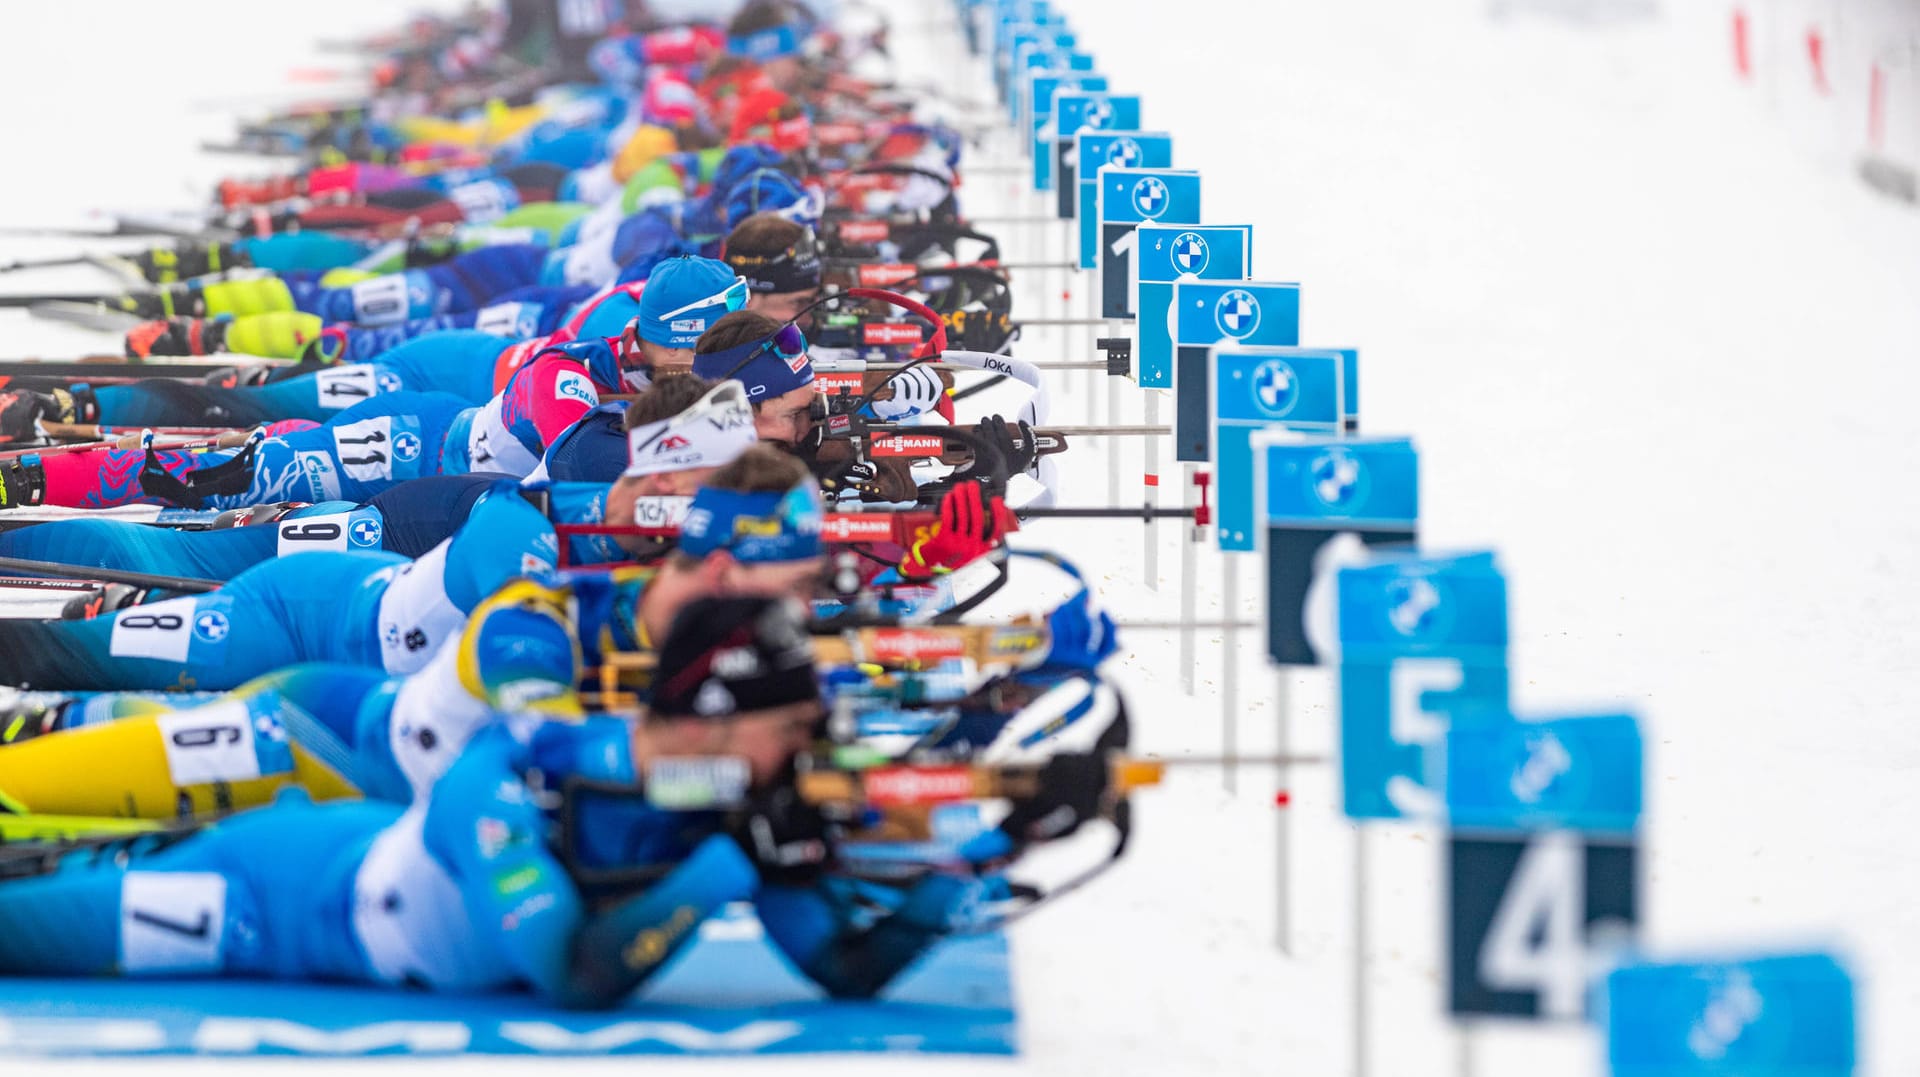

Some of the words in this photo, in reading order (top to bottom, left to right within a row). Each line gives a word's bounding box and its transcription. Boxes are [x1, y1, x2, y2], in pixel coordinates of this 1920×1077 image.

[984, 356, 1013, 376] JOKA
[321, 371, 369, 397] 14
[813, 376, 861, 392] ESSMANN
[339, 430, 386, 465] 11
[874, 435, 940, 452] VIESSMANN
[281, 523, 341, 541] 9
[822, 517, 890, 538] IESSMANN
[120, 615, 183, 630] 8
[173, 726, 240, 746] 6
[133, 911, 210, 939] 7
[1478, 830, 1595, 1018] 4
